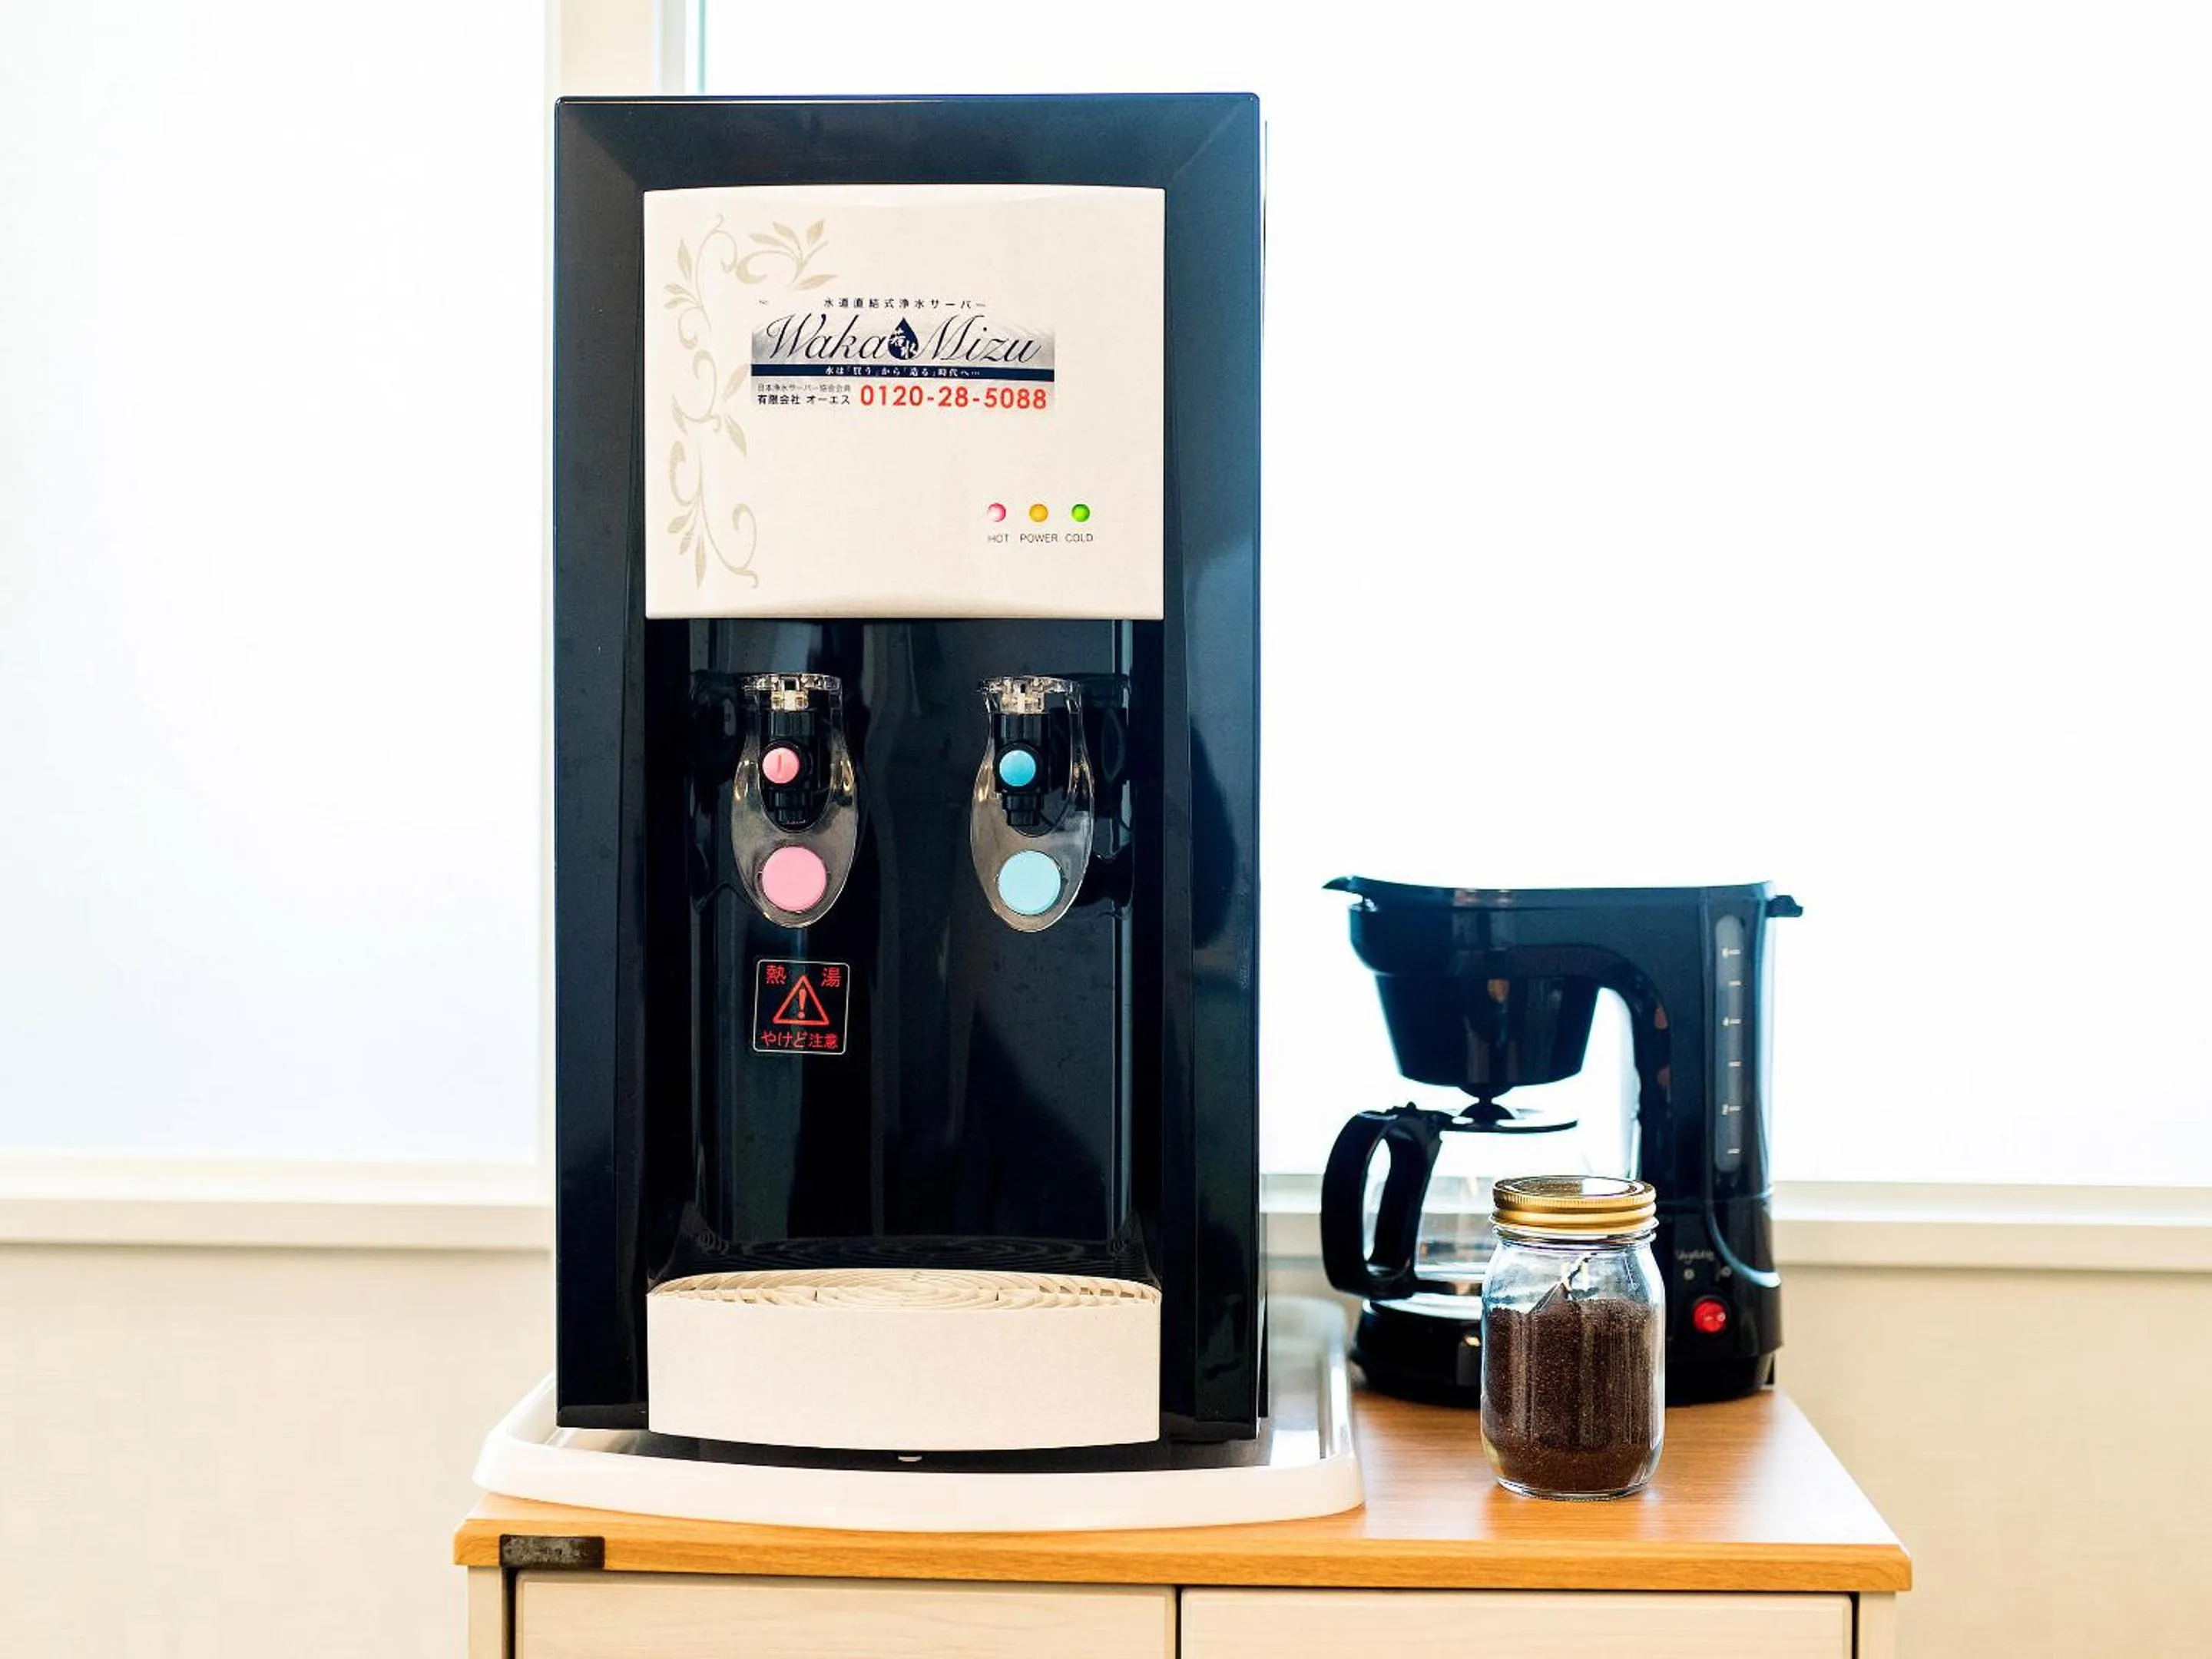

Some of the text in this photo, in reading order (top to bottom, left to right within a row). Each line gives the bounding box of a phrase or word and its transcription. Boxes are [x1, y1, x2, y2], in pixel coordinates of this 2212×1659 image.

[767, 313, 1043, 363] Waka Mizu
[757, 394, 850, 406] 有限会社 オーエス
[860, 384, 1047, 409] 0120-28-5088
[988, 533, 1094, 543] HOT POWER COLD
[760, 1031, 839, 1049] やけど注意
